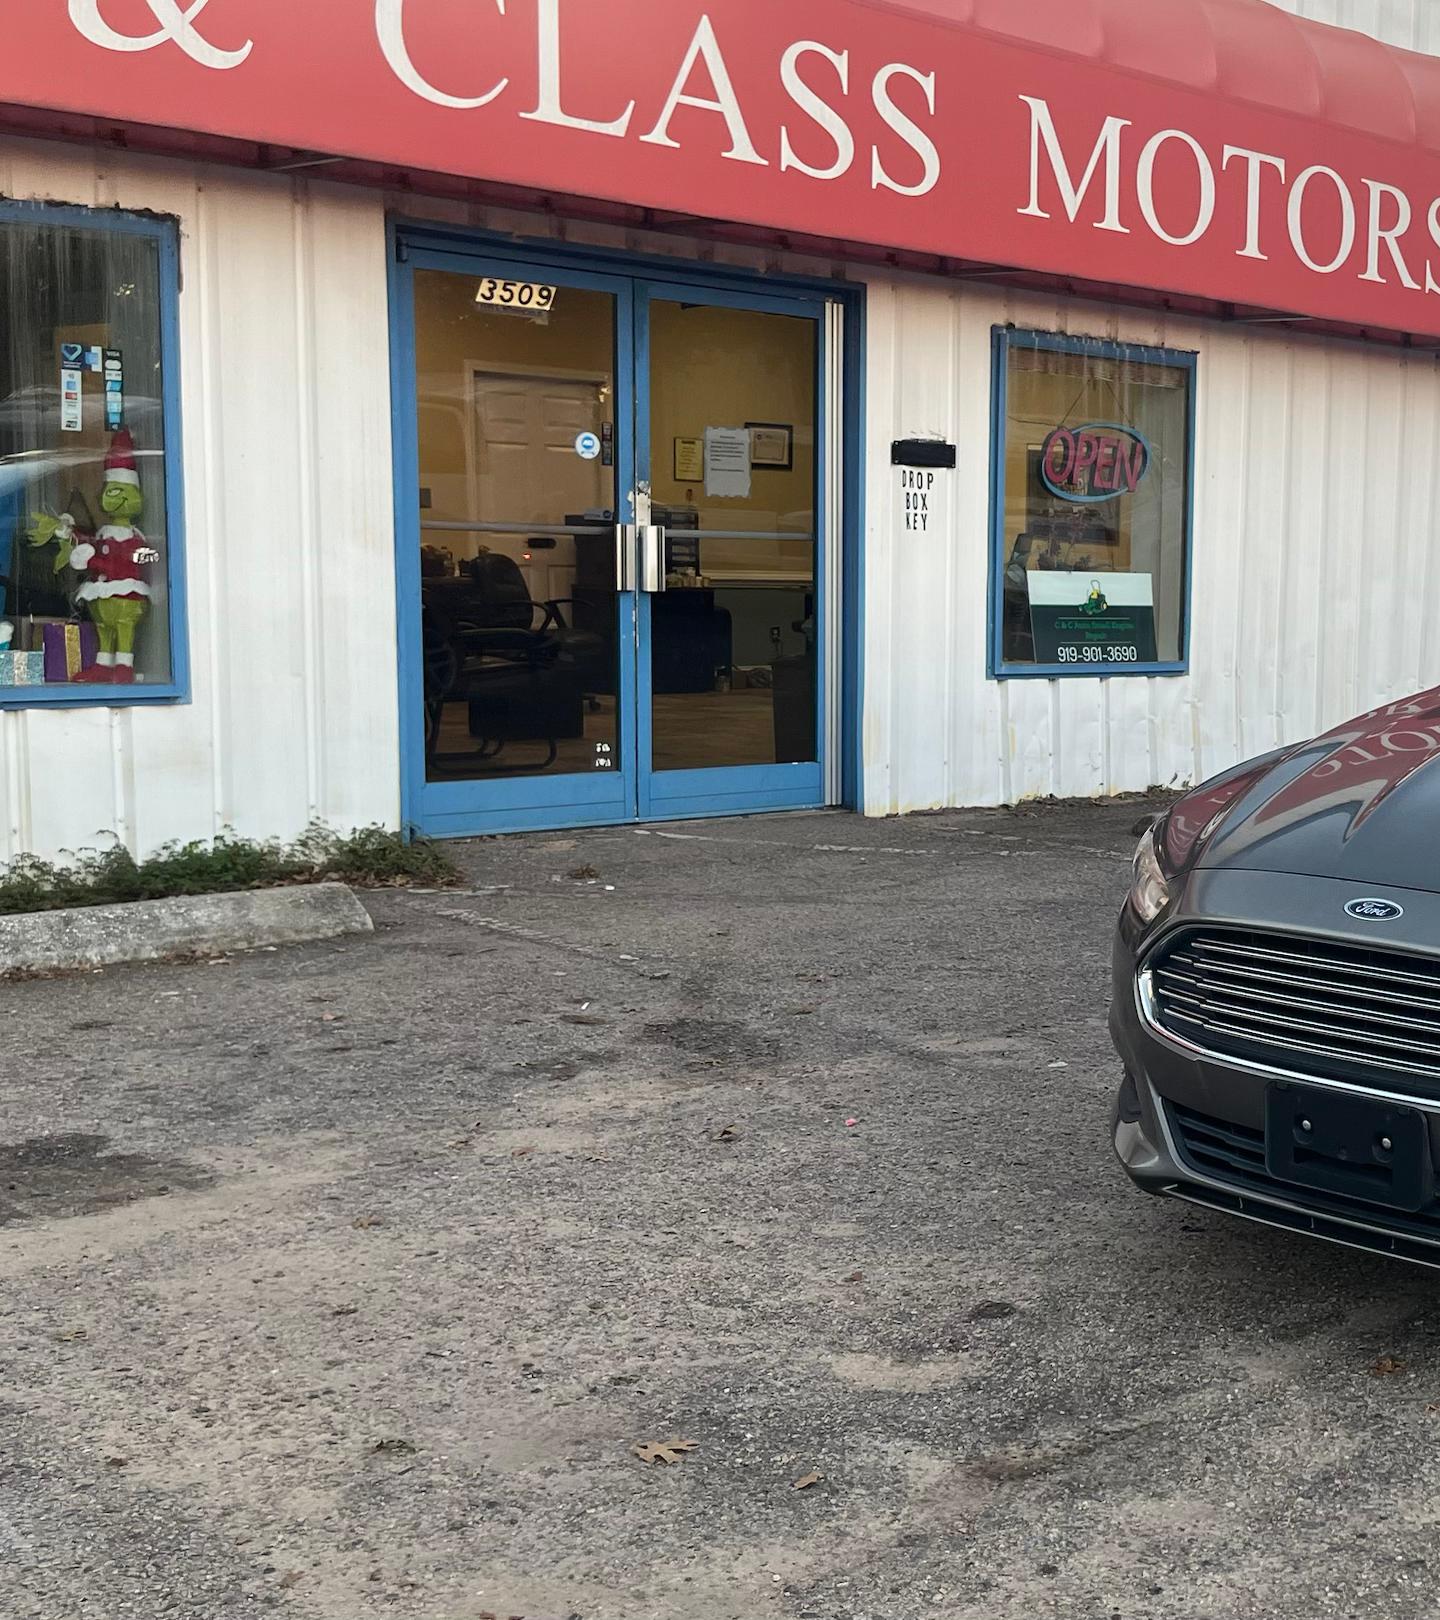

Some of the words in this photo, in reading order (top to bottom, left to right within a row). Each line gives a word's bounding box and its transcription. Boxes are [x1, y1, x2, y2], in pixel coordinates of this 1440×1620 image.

[374, 0, 942, 197] CLASS
[480, 278, 552, 307] 3509
[1044, 429, 1144, 493] OPEN
[902, 469, 934, 490] DROP
[905, 492, 928, 511] BOX
[905, 512, 928, 531] KEY
[1057, 646, 1138, 662] 919-901-3690
[1355, 901, 1391, 916] Ford
